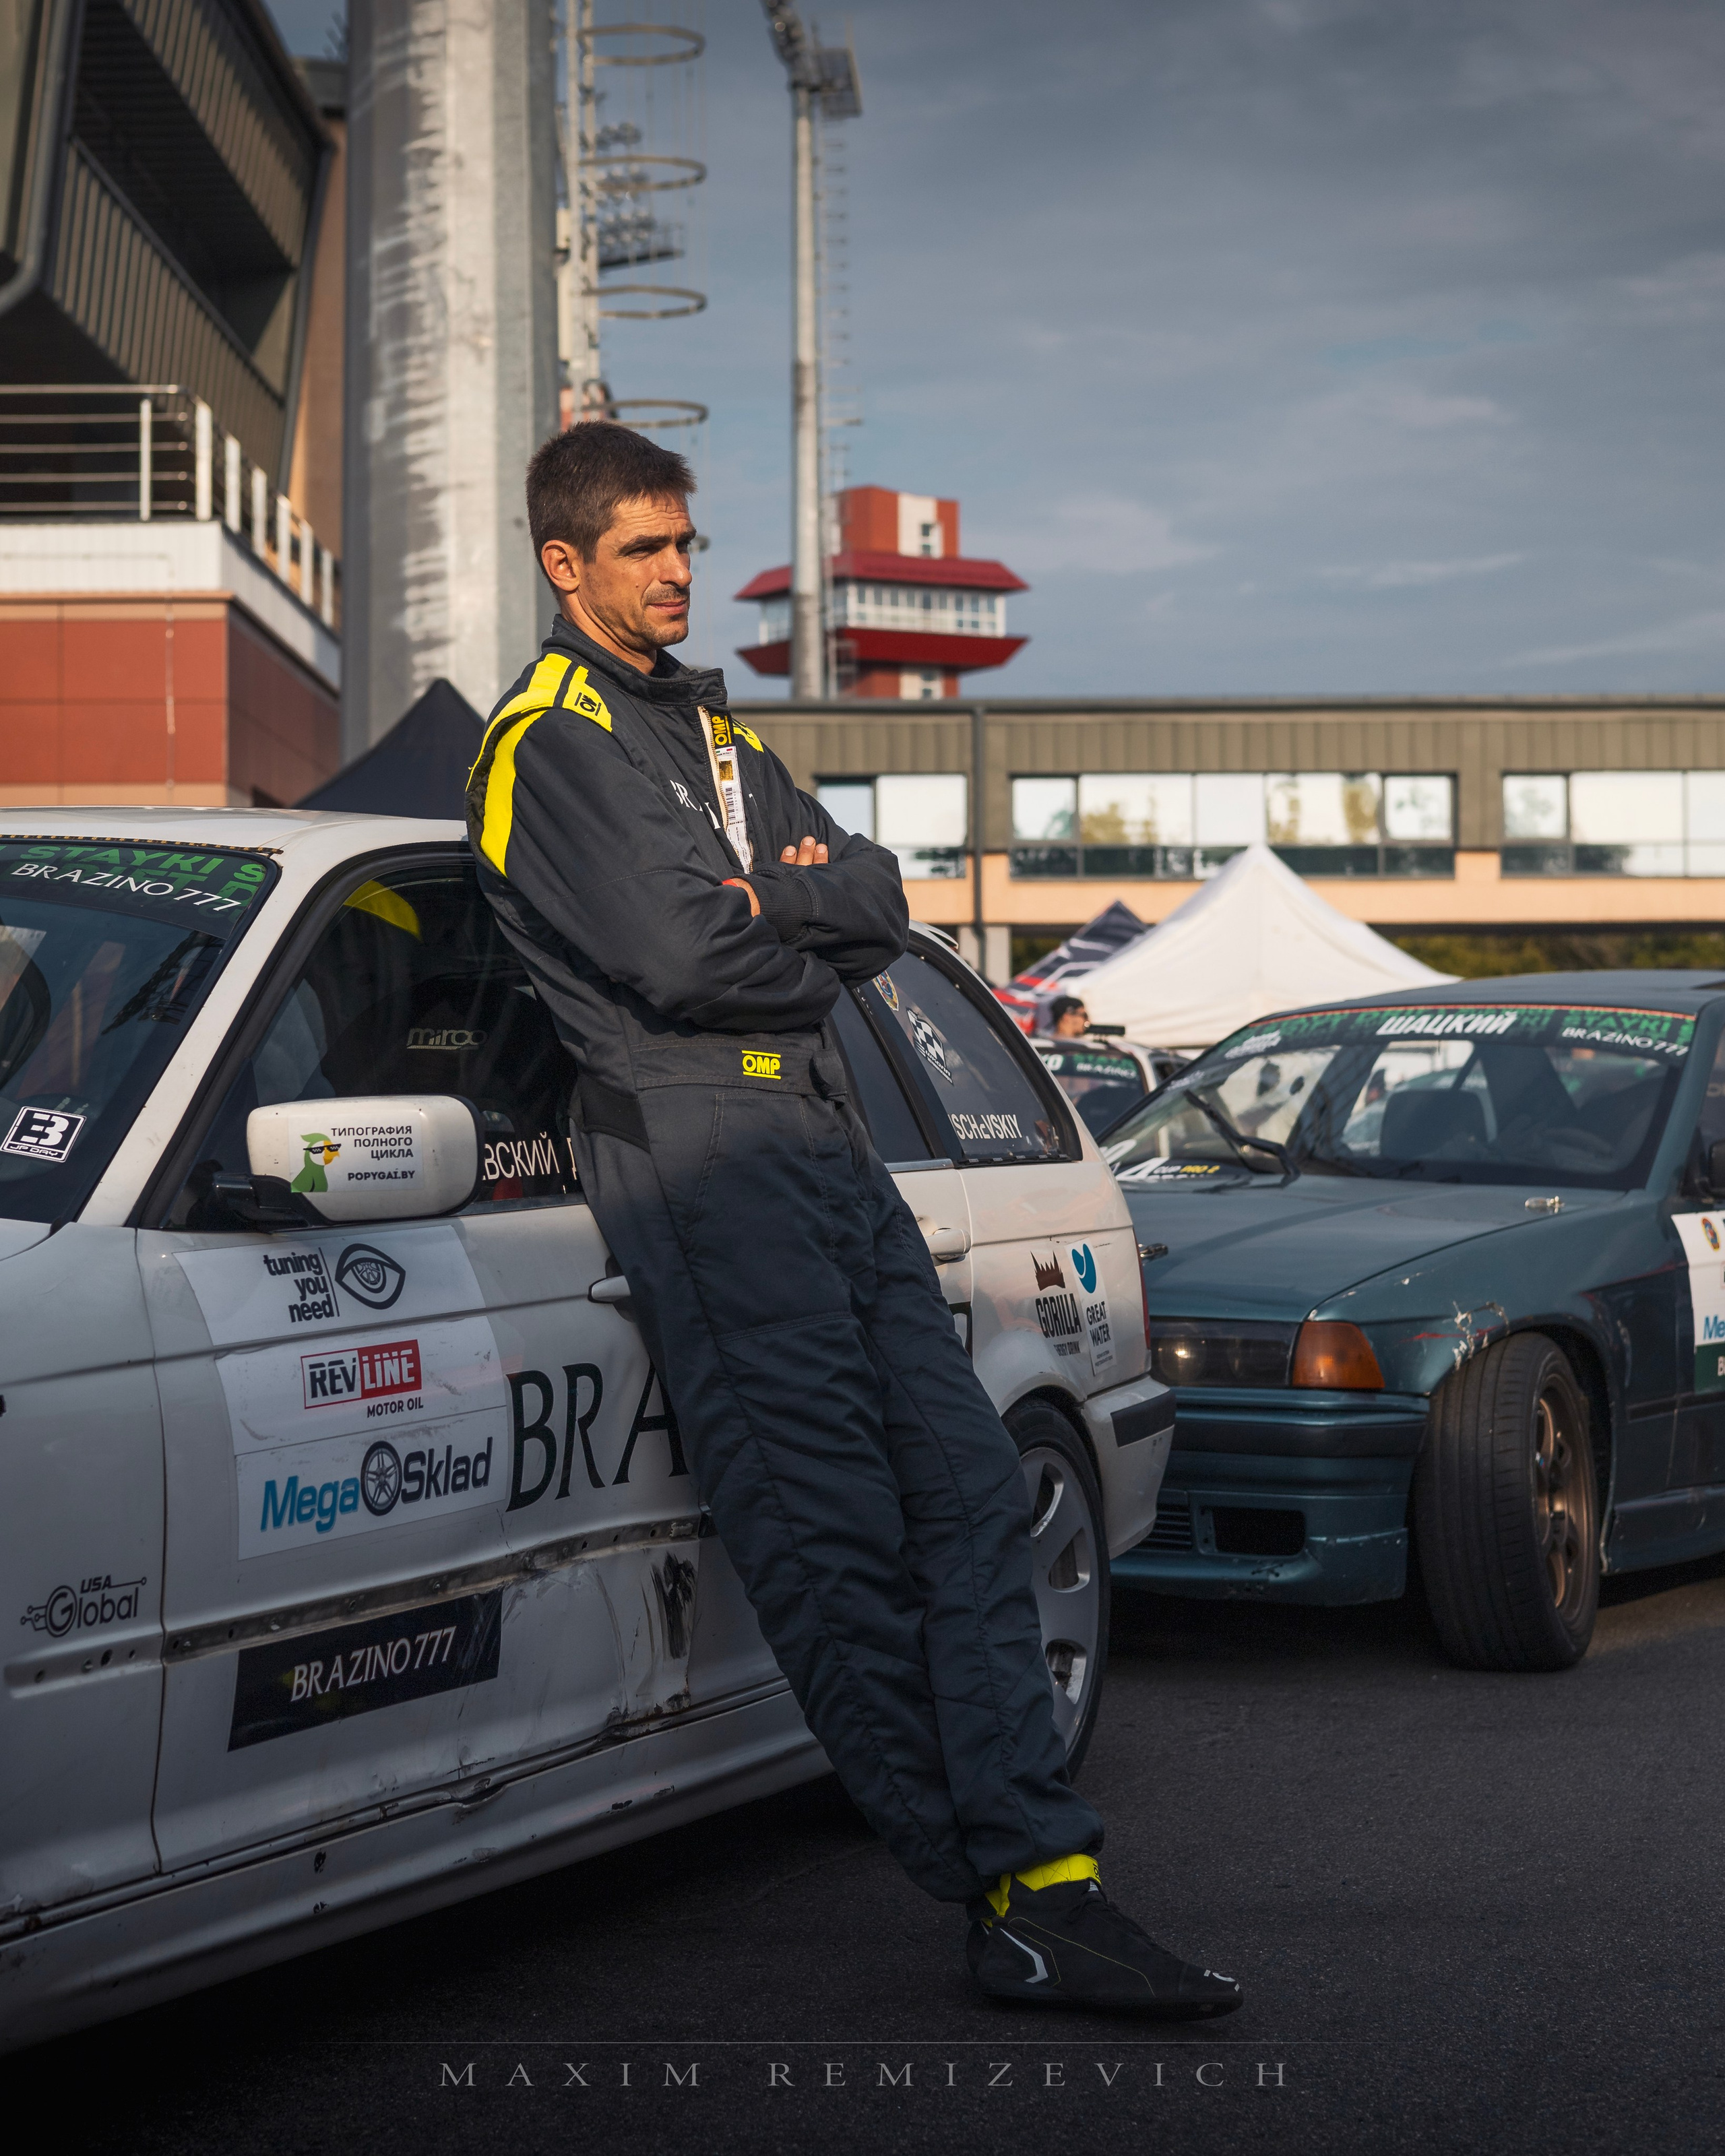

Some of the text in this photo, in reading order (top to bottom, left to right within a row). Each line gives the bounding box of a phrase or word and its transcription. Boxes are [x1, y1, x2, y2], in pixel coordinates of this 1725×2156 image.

[712, 716, 728, 746] OMP
[20, 846, 224, 875] STAYKI
[1376, 1011, 1517, 1036] ШАЦКИЙ
[742, 1054, 781, 1075] OMP
[331, 1125, 413, 1137] ТИПОГРАФИЯ
[354, 1137, 414, 1148] ПОЛНОГО
[29, 1147, 59, 1156] DAY
[371, 1149, 414, 1162] ЦИКЛА
[482, 1131, 561, 1180] ВСКИЙ
[263, 1252, 323, 1276] tuning
[294, 1276, 330, 1302] you
[288, 1294, 335, 1323] need
[1035, 1293, 1082, 1338] GORILLA
[1086, 1300, 1106, 1325] GREAT
[1090, 1323, 1111, 1347] WATER
[367, 1397, 424, 1418] MOTOR OIL
[80, 1575, 112, 1594] USA
[48, 1587, 139, 1632] Global
